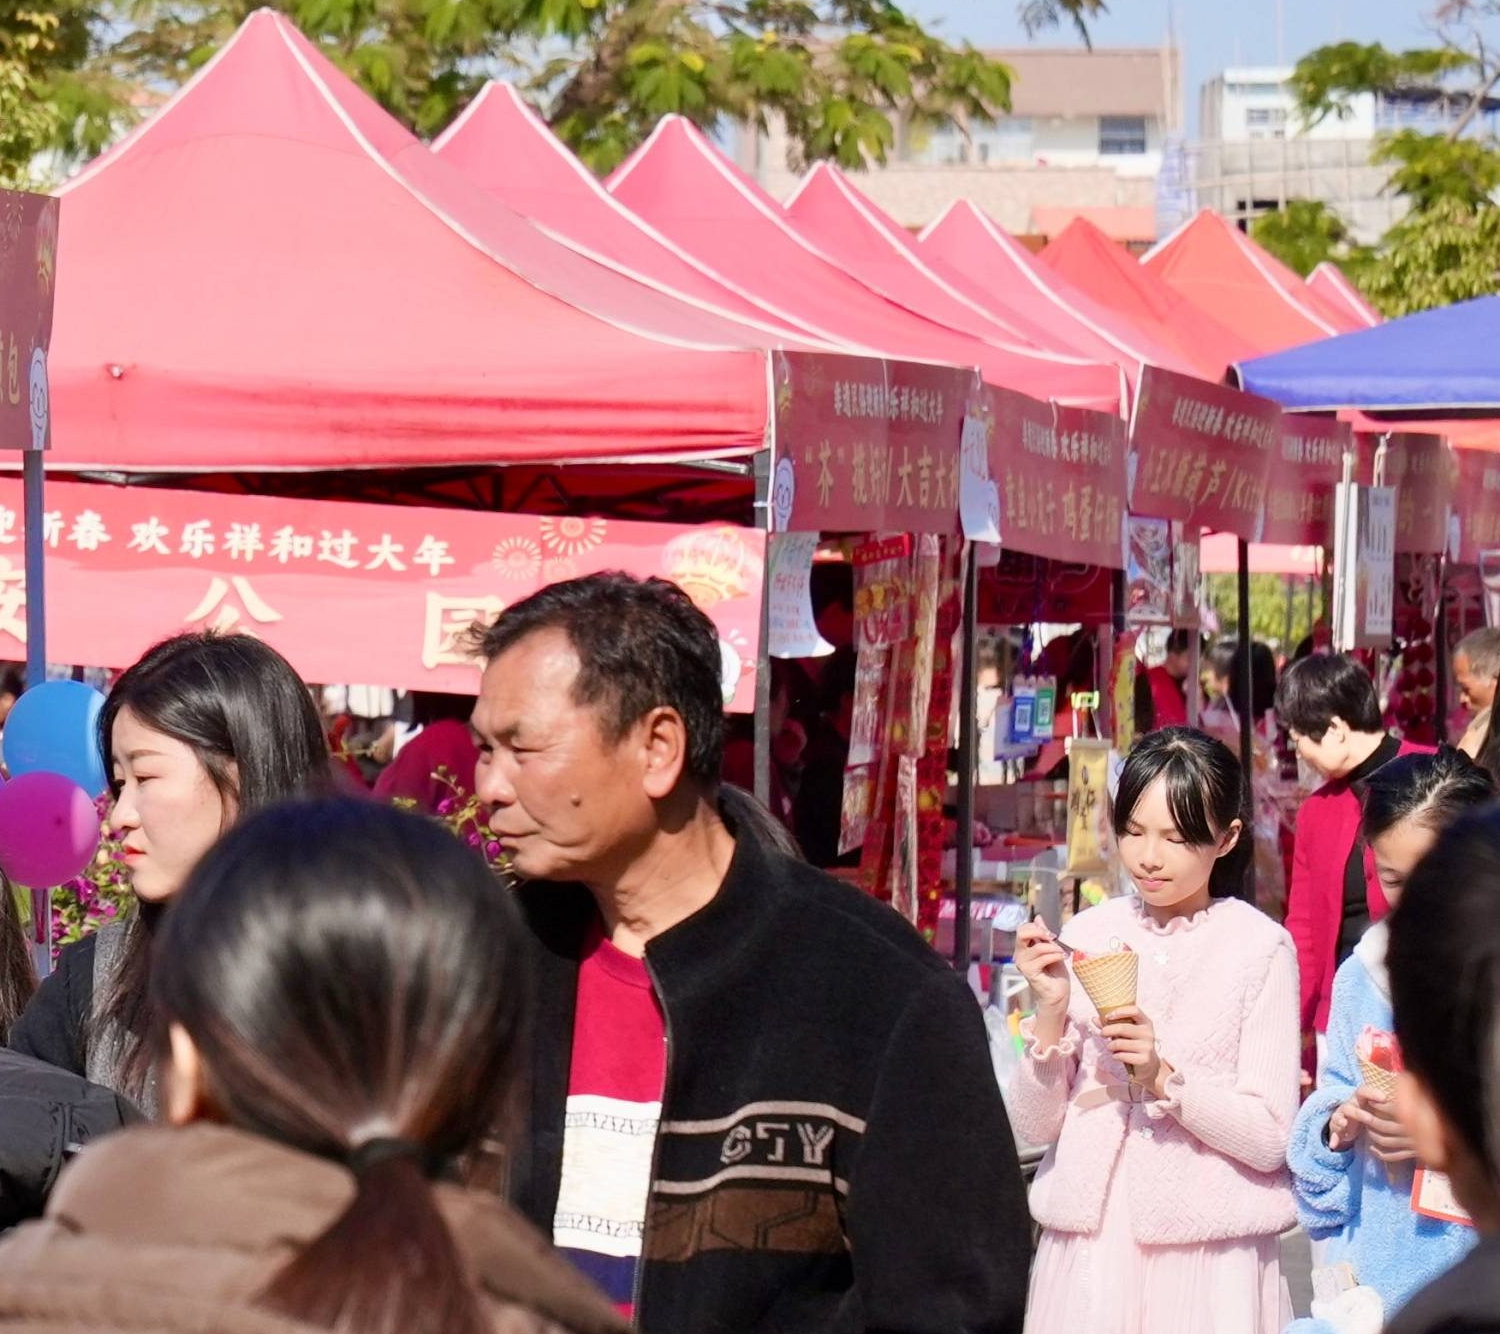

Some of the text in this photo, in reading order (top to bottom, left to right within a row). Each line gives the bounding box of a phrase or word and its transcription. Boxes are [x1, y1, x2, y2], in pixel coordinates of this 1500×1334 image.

[126, 516, 456, 575] 欢乐祥和过大年
